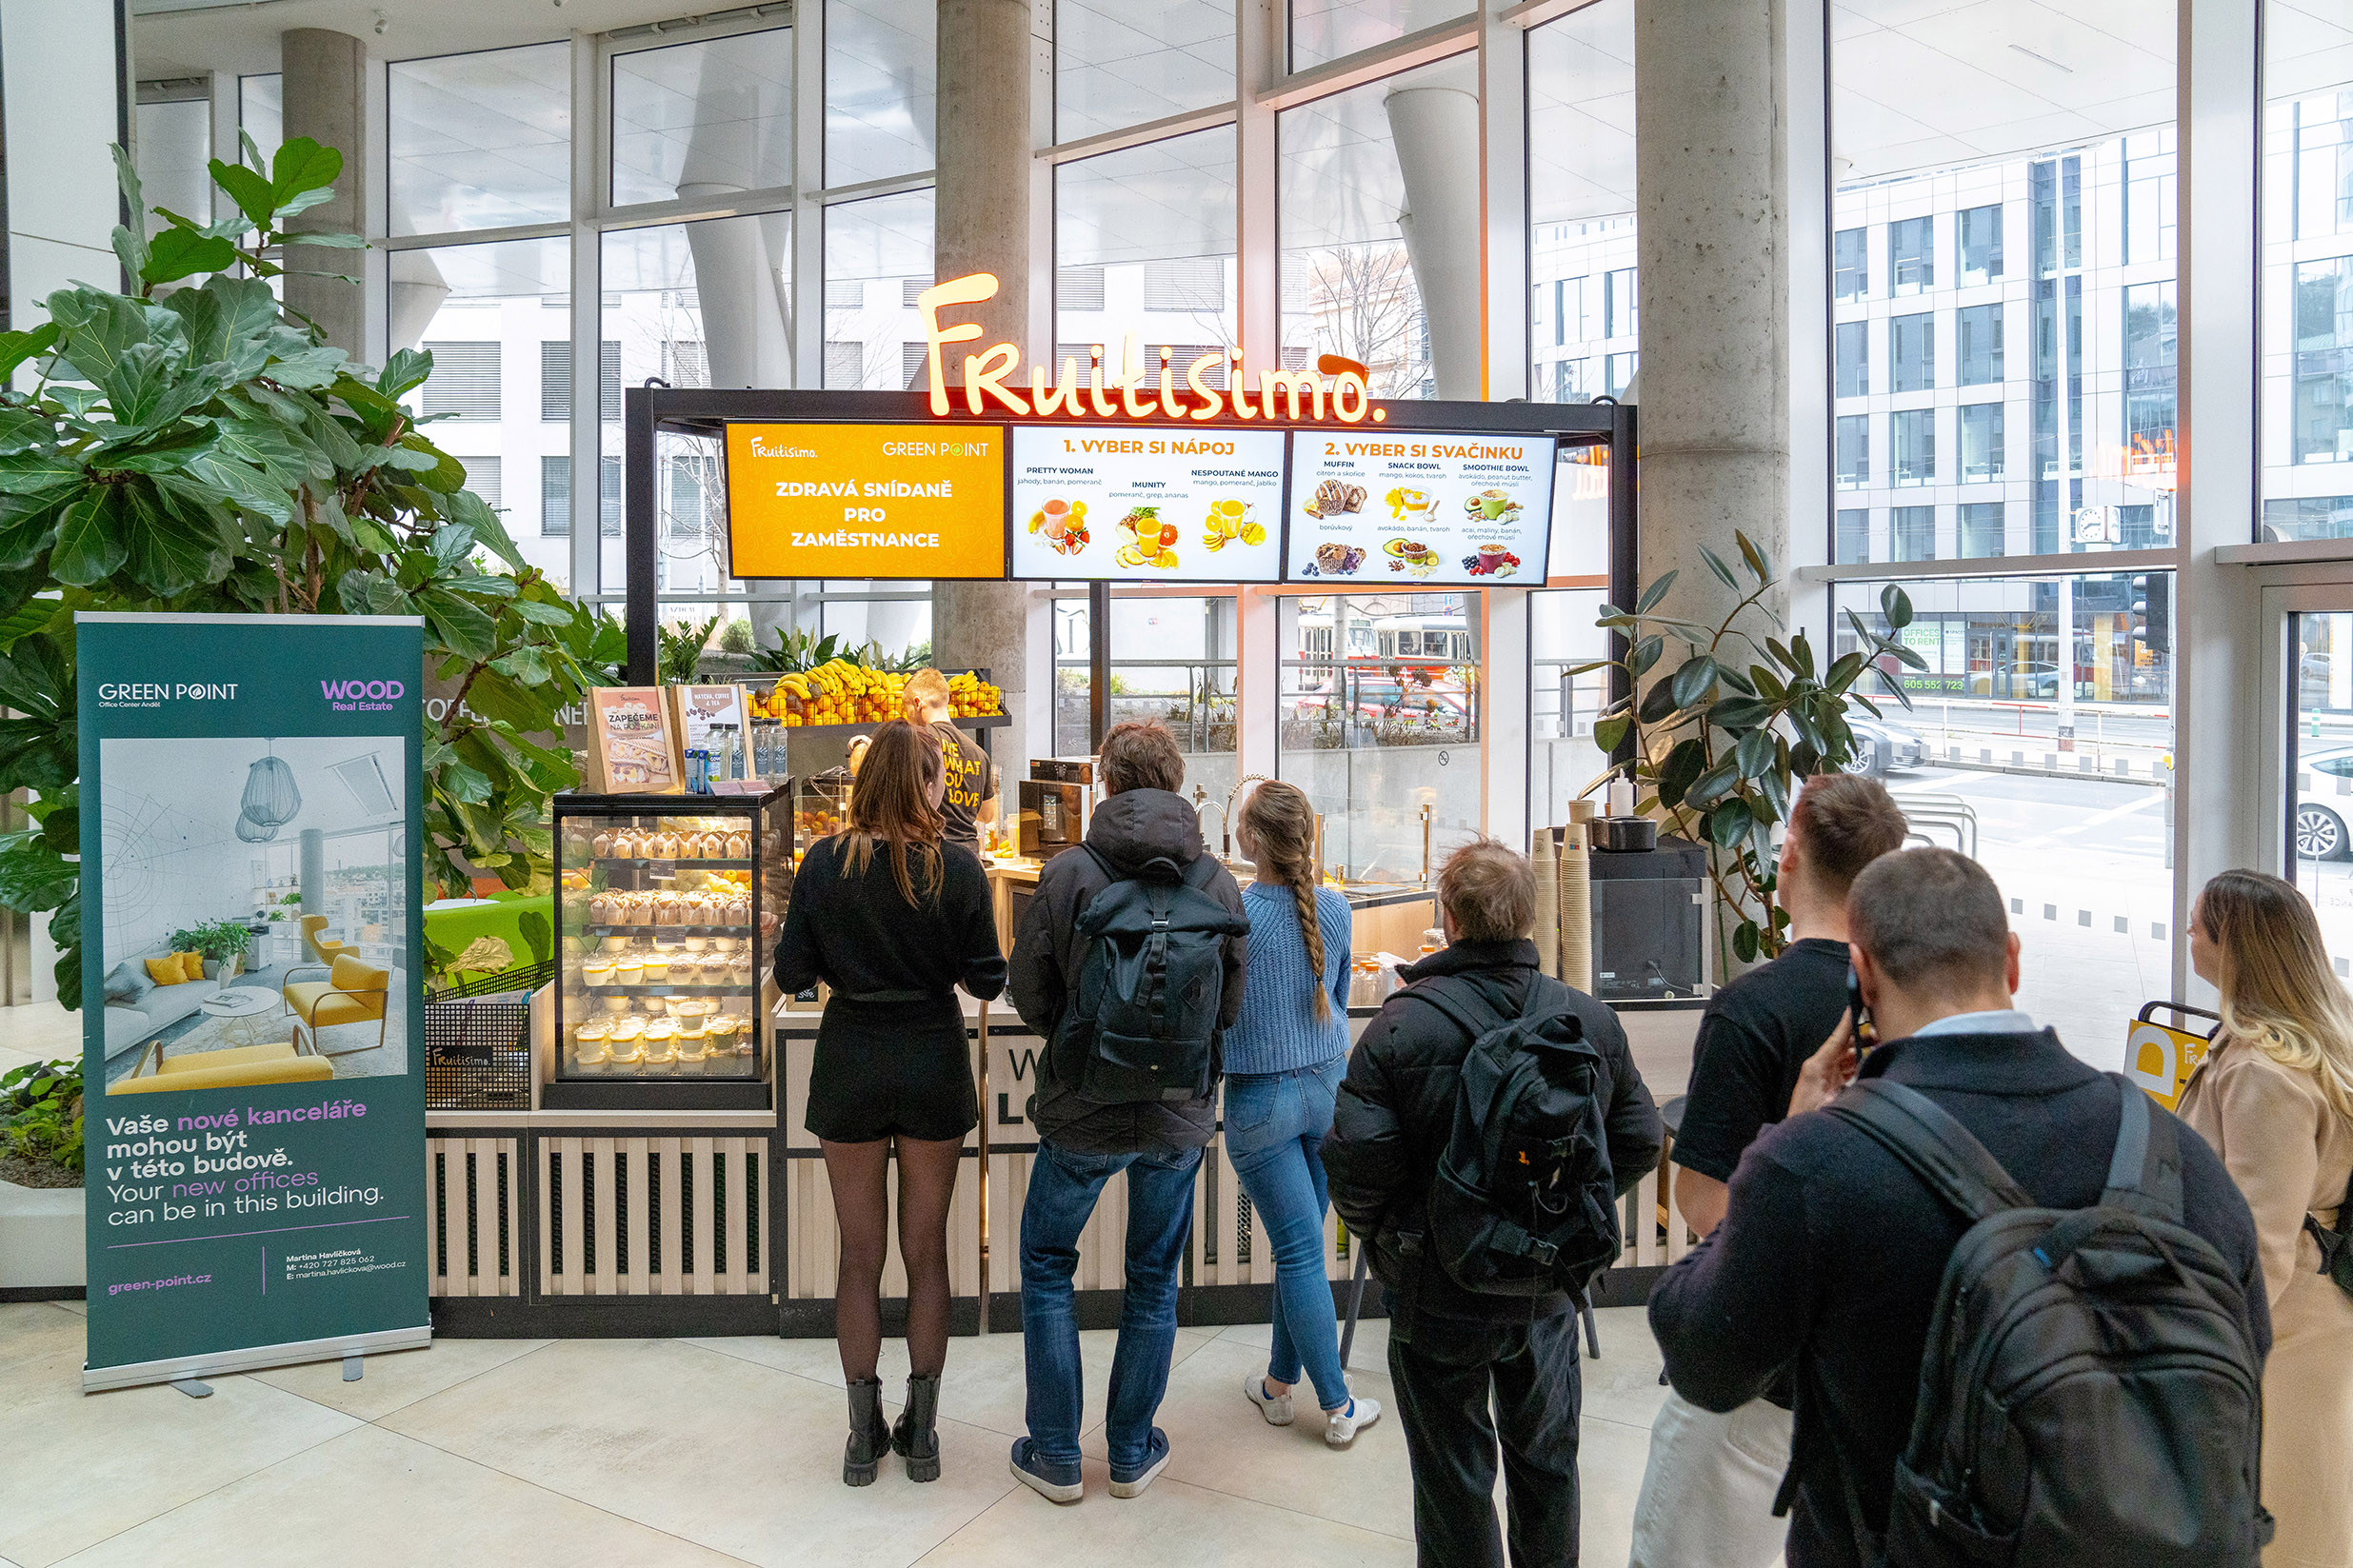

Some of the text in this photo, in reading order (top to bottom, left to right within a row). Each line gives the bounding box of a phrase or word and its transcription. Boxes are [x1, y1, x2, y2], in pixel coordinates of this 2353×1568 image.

[883, 442, 988, 457] GREEN POINT
[1064, 438, 1235, 455] 1. VYBER SI NÁPOJ
[1325, 442, 1524, 460] 2. VYBER SI SVAČINKU
[776, 479, 952, 497] ZDRAVÁ SNÍDANĚ
[844, 507, 886, 523] PRO
[791, 528, 940, 547] ZAMĚSTNANCE
[1477, 526, 1500, 535] maliny,
[1904, 628, 1941, 637] OFFICES
[1904, 637, 1917, 645] TO
[1918, 637, 1941, 645] RENT
[98, 683, 238, 700] GREEN POINT
[320, 680, 405, 700] WOOD
[1904, 680, 1964, 690] 605 552 723
[332, 701, 393, 711] Real Estate
[608, 712, 659, 723] ZAPEČEME
[943, 754, 981, 776] WHAT
[944, 772, 964, 788] OU
[948, 788, 980, 807] LOVE
[106, 1099, 367, 1137] Vaše nové kanceláře
[107, 1130, 248, 1160] mohou být
[106, 1148, 293, 1181] v této budově.
[107, 1171, 319, 1204] Your new offices
[108, 1185, 385, 1226] can be in this building.
[286, 1248, 362, 1262] Martina Havlíčková
[358, 1255, 375, 1263] 062
[295, 1261, 407, 1280] martina.havlickova@wood.cz
[109, 1272, 211, 1296] green-point.cz
